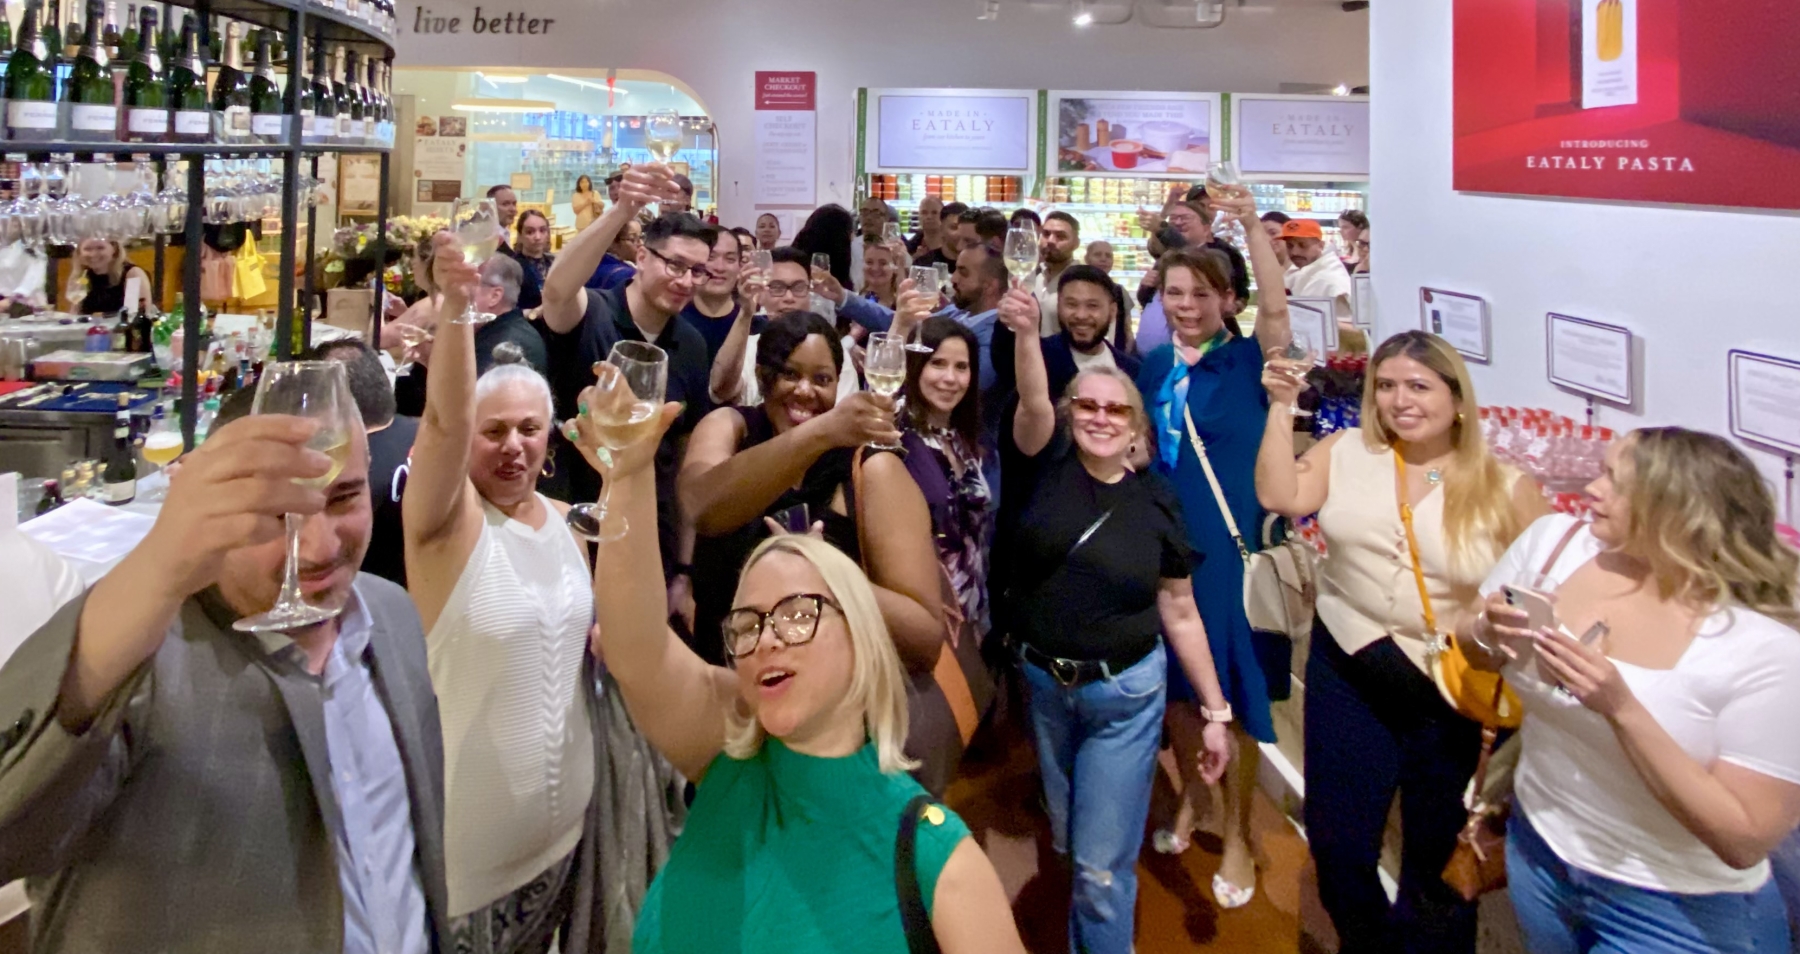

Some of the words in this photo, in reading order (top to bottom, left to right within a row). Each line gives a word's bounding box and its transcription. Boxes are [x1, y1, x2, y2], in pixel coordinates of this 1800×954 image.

[413, 6, 460, 34] live
[473, 6, 555, 35] better
[768, 76, 801, 84] MARKET
[764, 83, 807, 91] CHECKOUT
[912, 119, 995, 132] EATALY
[1272, 123, 1355, 136] EATALY
[1560, 139, 1649, 148] INTRODUCING
[1526, 156, 1606, 170] EATALY
[1617, 157, 1695, 172] PASTA
